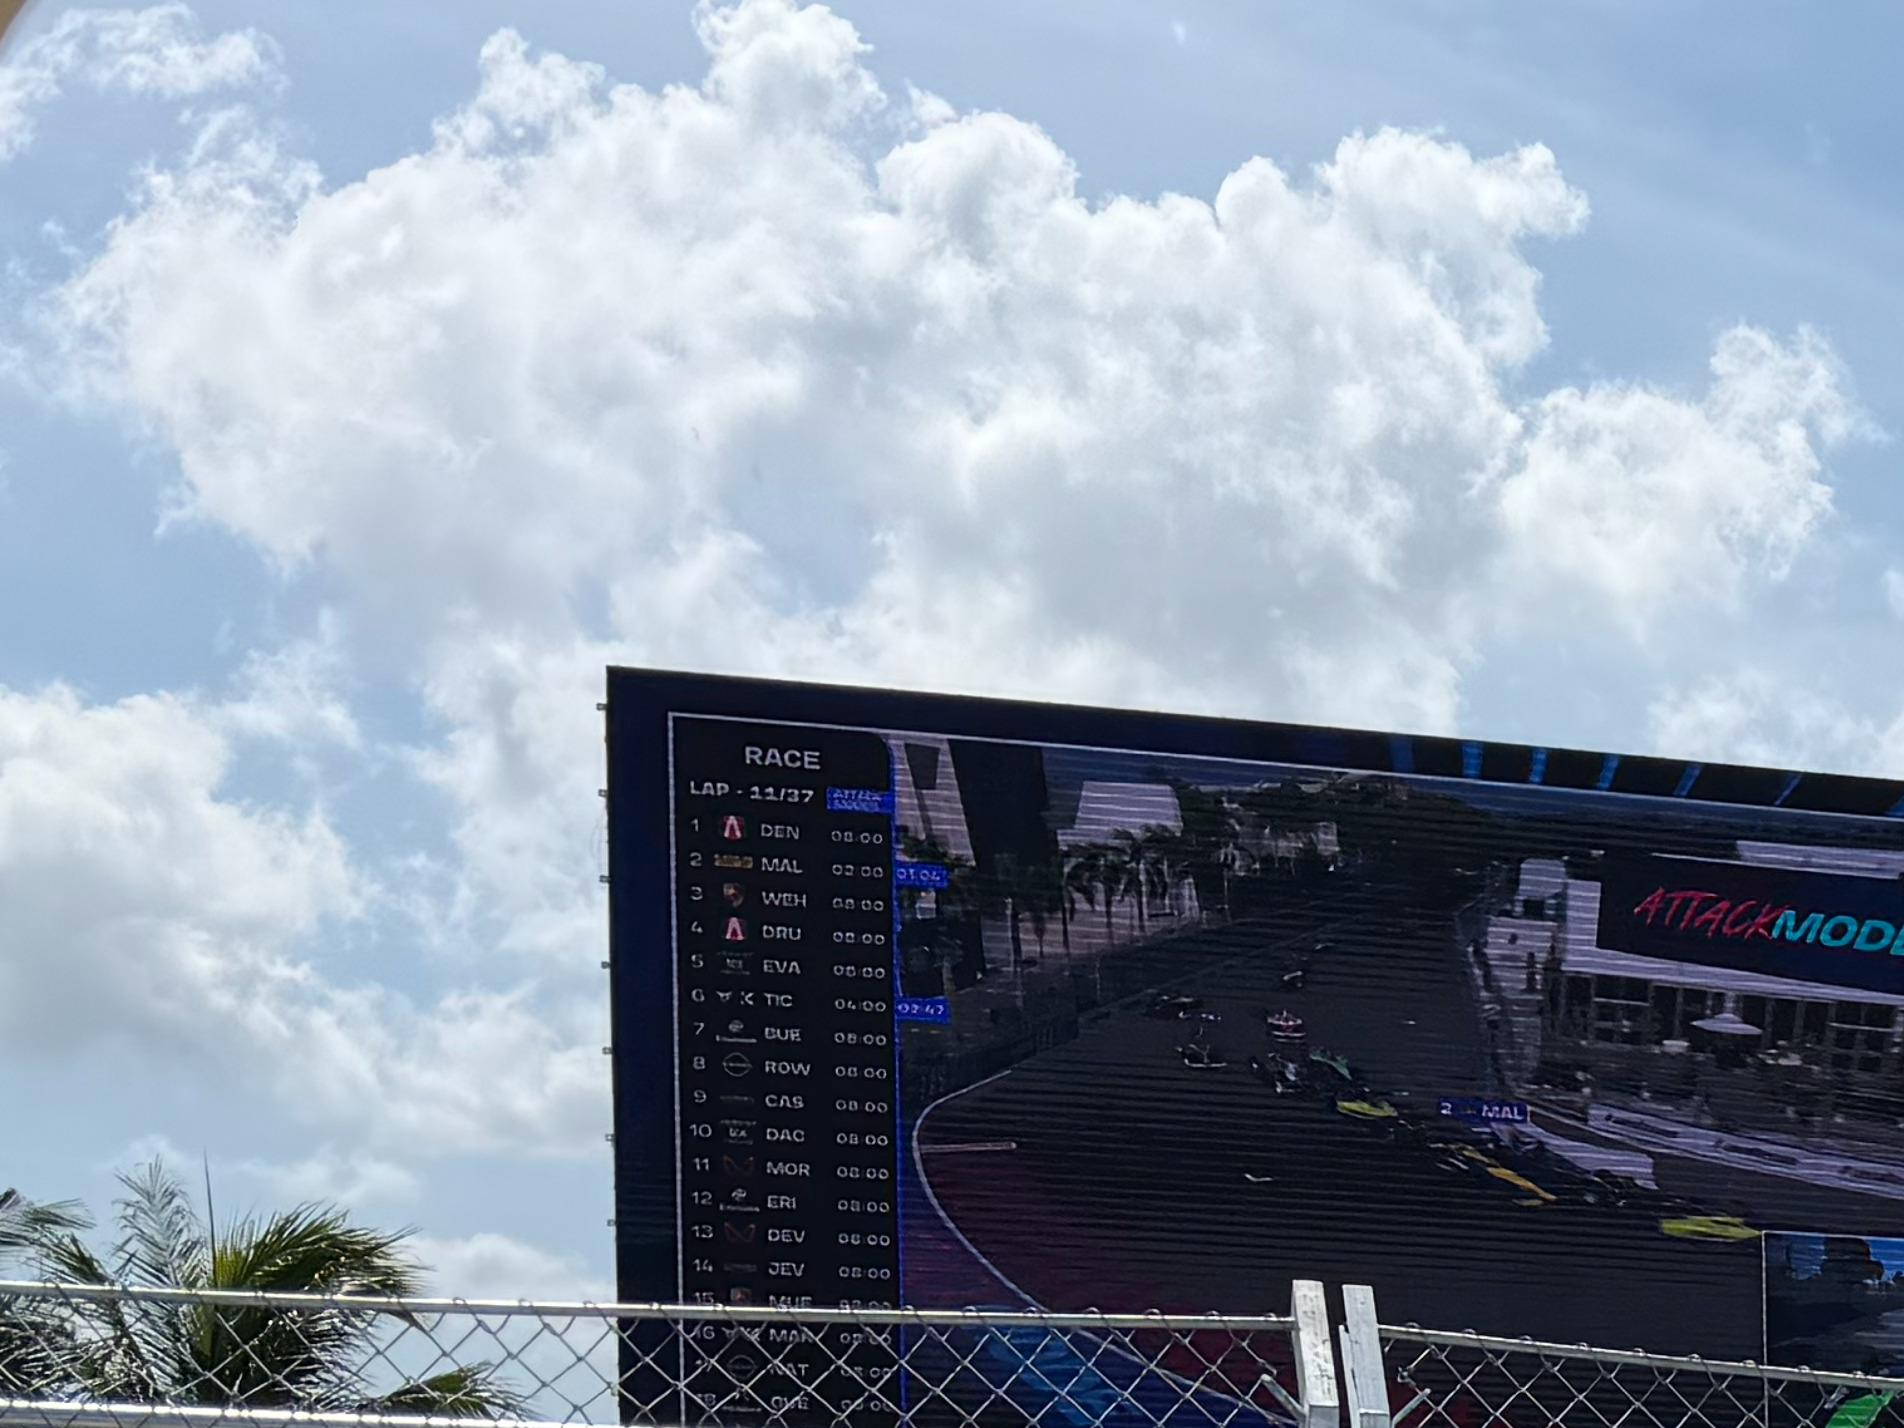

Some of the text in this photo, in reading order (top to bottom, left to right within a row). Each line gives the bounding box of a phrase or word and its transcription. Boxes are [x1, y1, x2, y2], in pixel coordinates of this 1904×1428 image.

[744, 746, 821, 770] RACE
[690, 781, 729, 797] LAP
[750, 786, 814, 802] 11/37
[691, 818, 699, 832] 1
[760, 823, 800, 840] DEN
[690, 852, 702, 867] 2
[761, 857, 803, 874] MAL
[690, 886, 703, 901] 3
[762, 891, 807, 908] WEH
[1634, 886, 1786, 940] ATTACK
[691, 921, 703, 934] 4
[763, 960, 801, 975] EVA
[763, 993, 793, 1007] TIC
[694, 1022, 705, 1036] 7
[693, 1056, 706, 1070] 8
[764, 1060, 811, 1076] ROW
[693, 1089, 707, 1103] 9
[765, 1094, 804, 1109] CAS
[689, 1123, 713, 1138] 10
[693, 1157, 710, 1172] 11
[766, 1161, 811, 1177] MOR
[691, 1191, 713, 1205] 12
[691, 1224, 714, 1239] 13
[767, 1229, 806, 1243] DEV
[692, 1258, 713, 1273] 14
[767, 1261, 805, 1277] JEV
